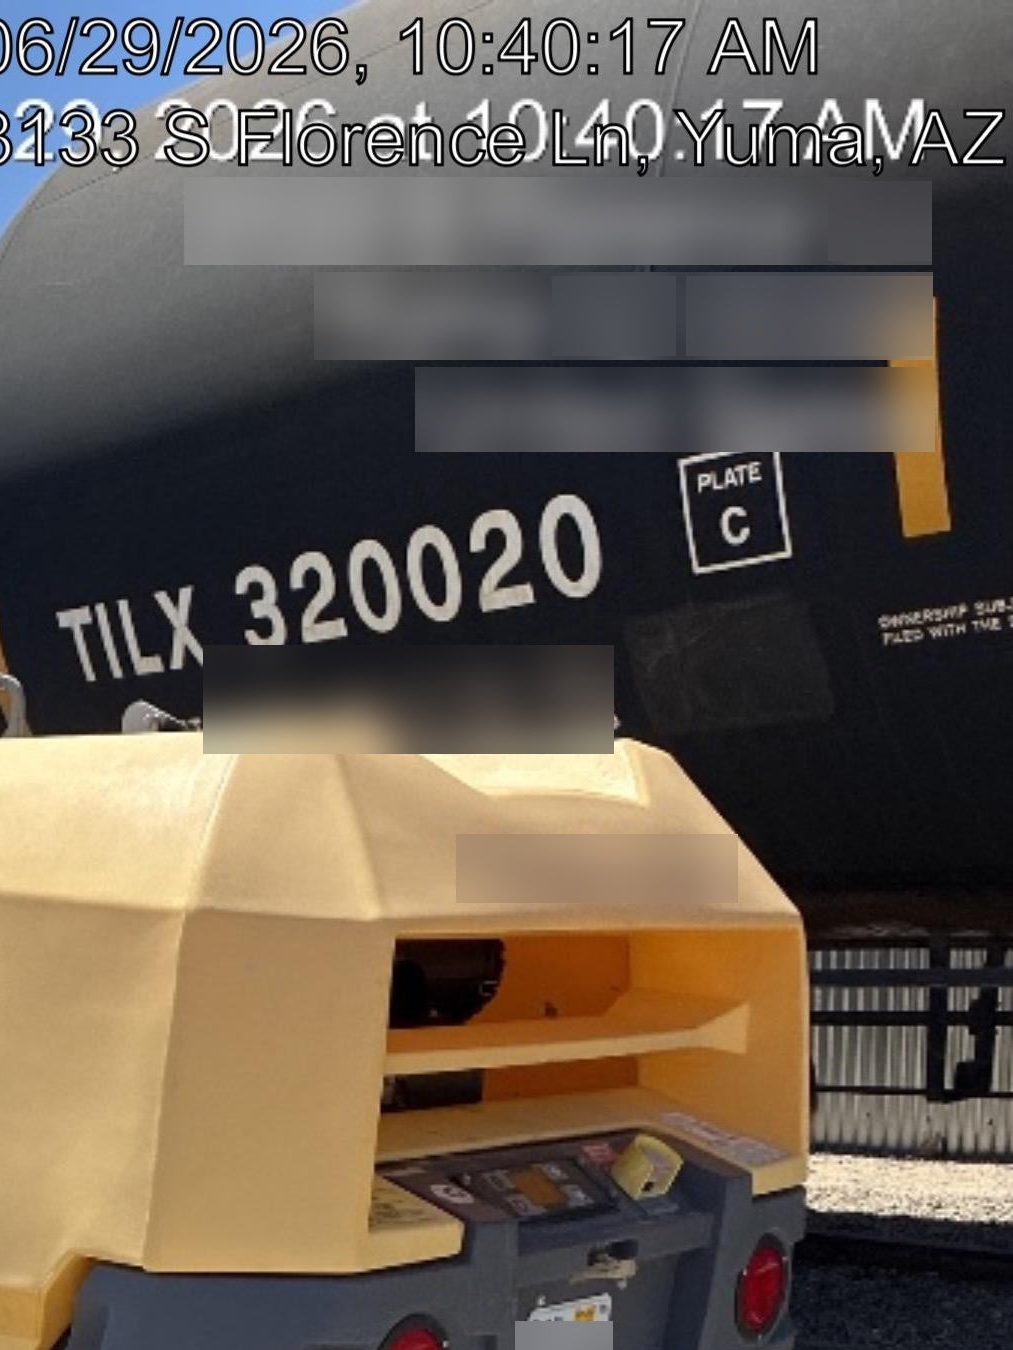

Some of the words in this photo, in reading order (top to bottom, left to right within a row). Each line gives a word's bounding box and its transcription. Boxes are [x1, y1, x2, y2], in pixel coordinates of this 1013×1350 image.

[697, 461, 763, 494] PLATE
[720, 505, 750, 546] C
[55, 585, 203, 682] TILX
[234, 494, 603, 645] 320020
